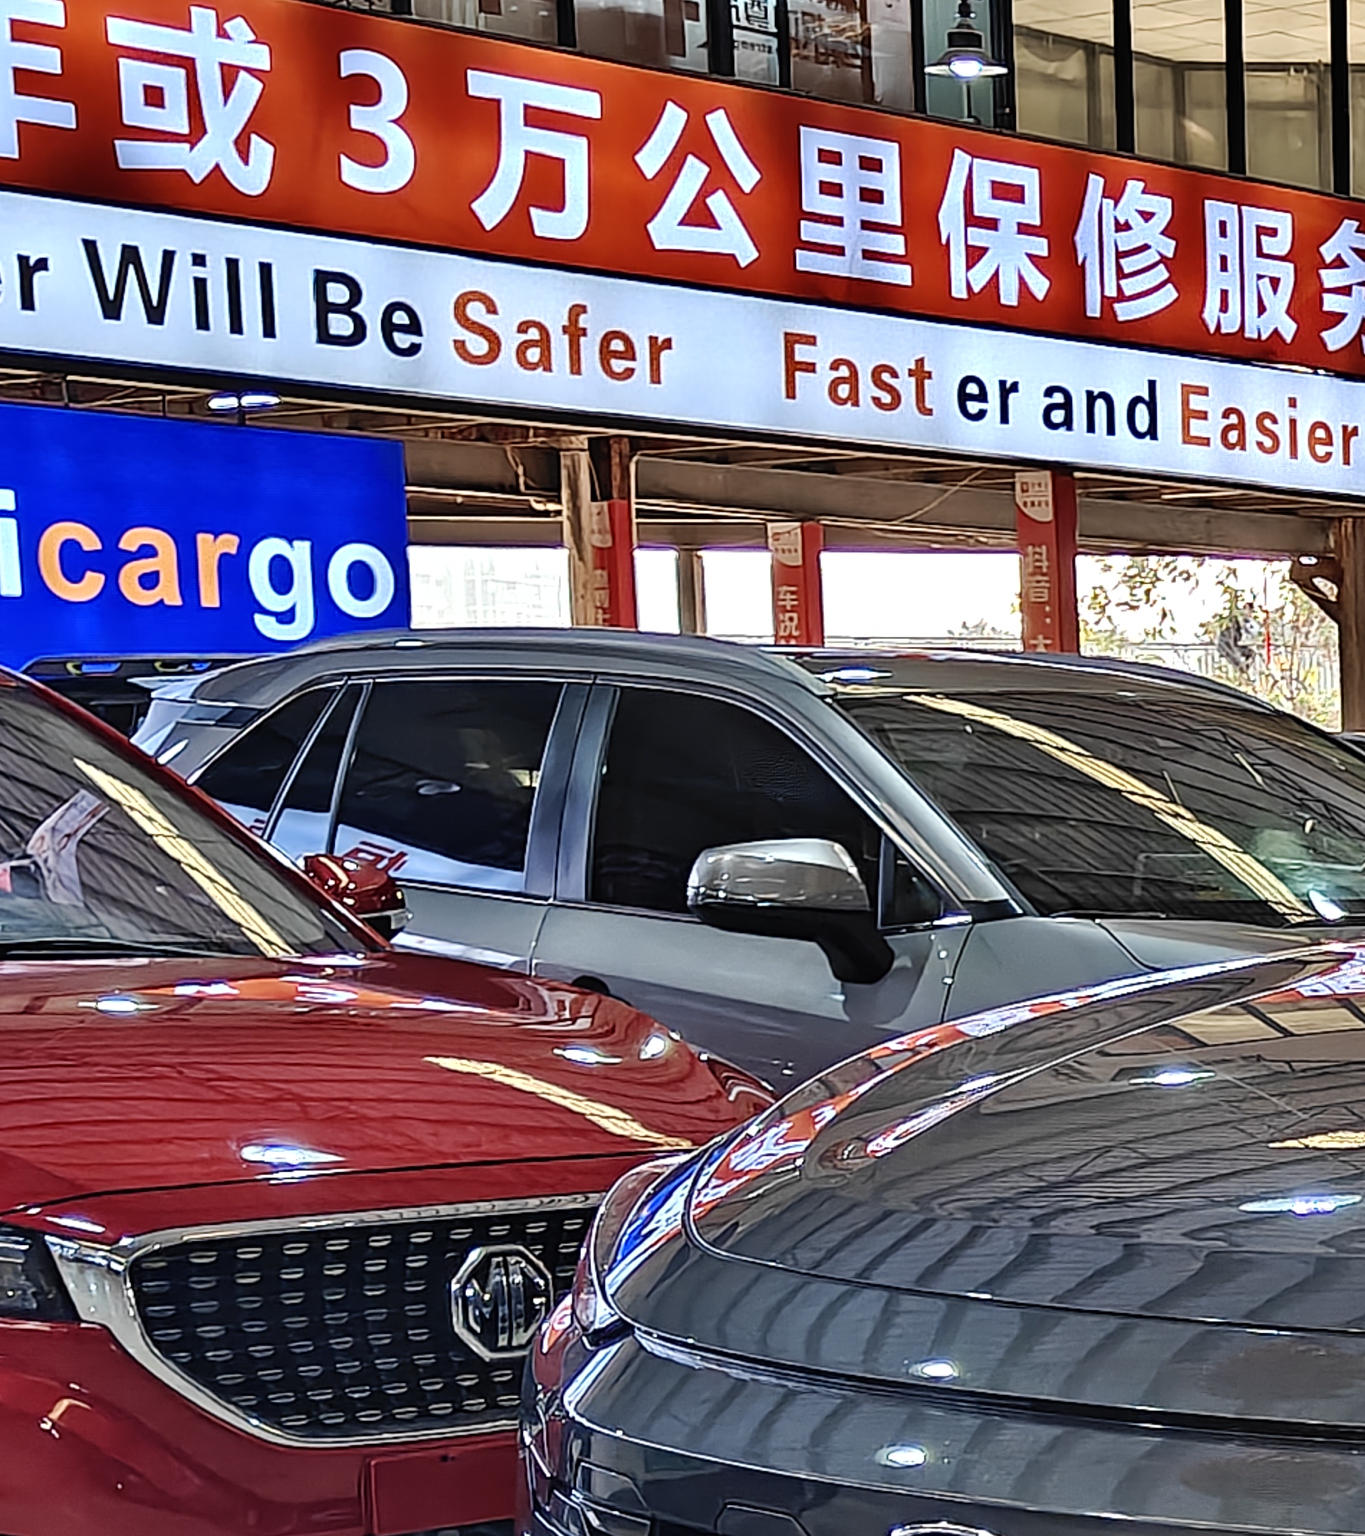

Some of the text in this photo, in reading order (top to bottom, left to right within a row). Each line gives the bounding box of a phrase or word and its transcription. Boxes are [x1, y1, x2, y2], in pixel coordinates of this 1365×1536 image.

[81, 238, 277, 338] Will
[313, 268, 424, 358] Be
[452, 290, 673, 385] Safer
[783, 331, 934, 417] Fast
[1042, 379, 1159, 441] and
[1180, 383, 1359, 466] Easier
